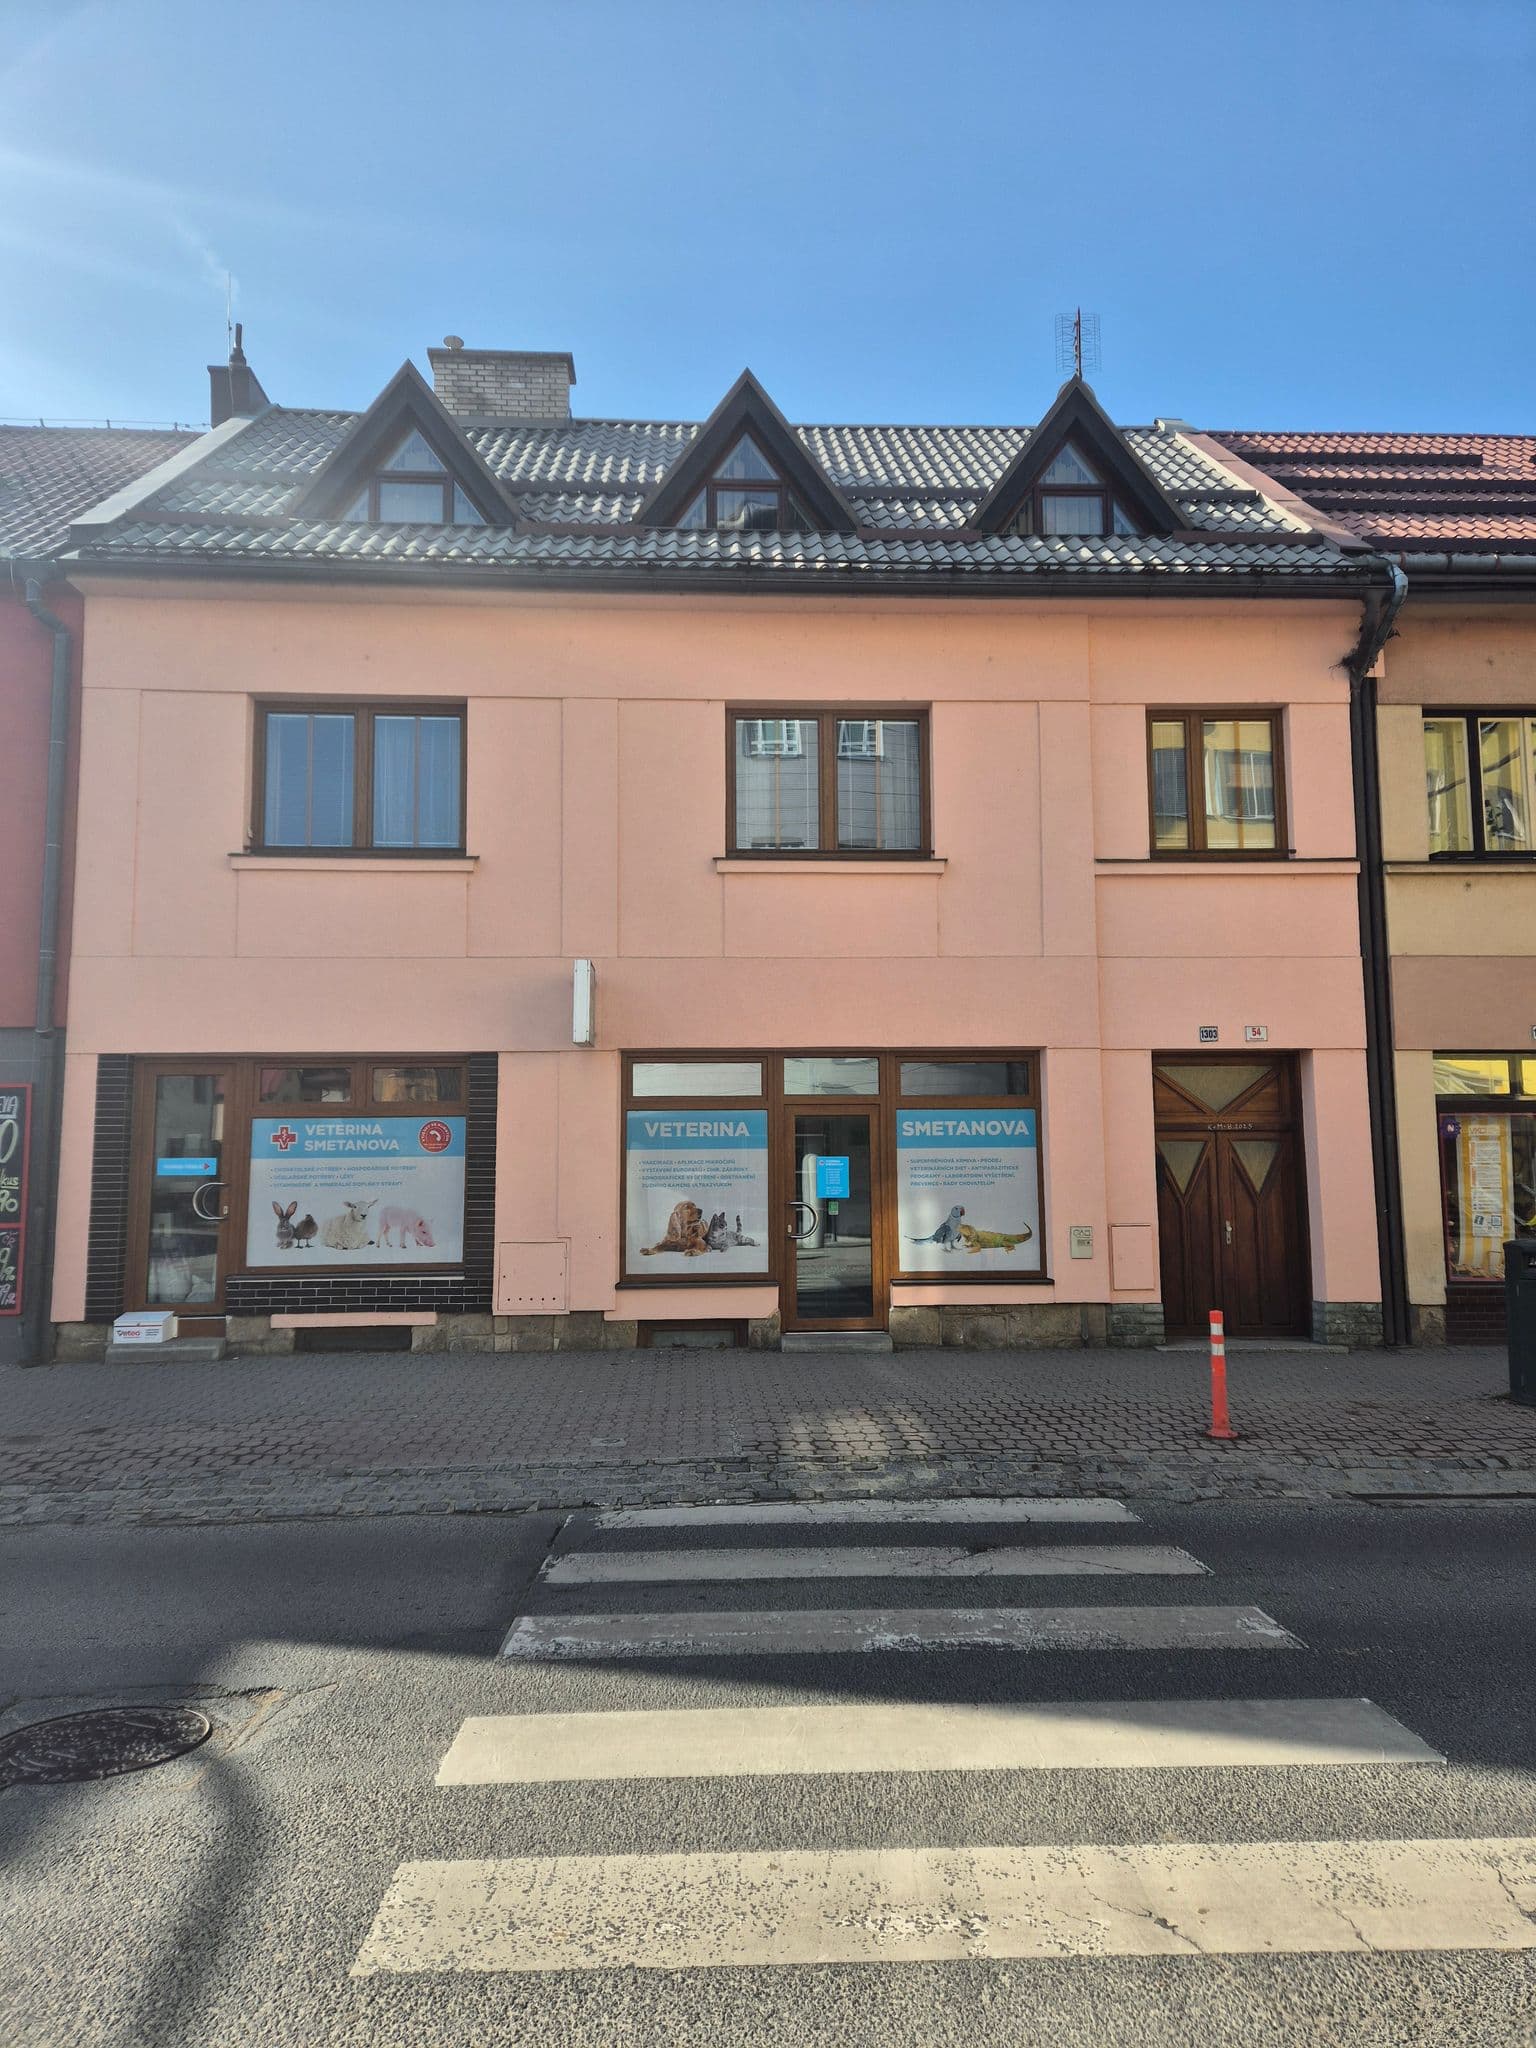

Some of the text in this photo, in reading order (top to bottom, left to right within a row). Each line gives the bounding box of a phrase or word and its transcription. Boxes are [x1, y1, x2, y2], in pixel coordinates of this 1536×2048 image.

[1201, 1029, 1218, 1038] 1303
[1251, 1028, 1261, 1036] 54
[305, 1124, 383, 1136] VETERINA
[644, 1122, 750, 1137] VETERINA
[902, 1120, 1029, 1137] SMETANOVA
[304, 1139, 400, 1151] SMETANOVA
